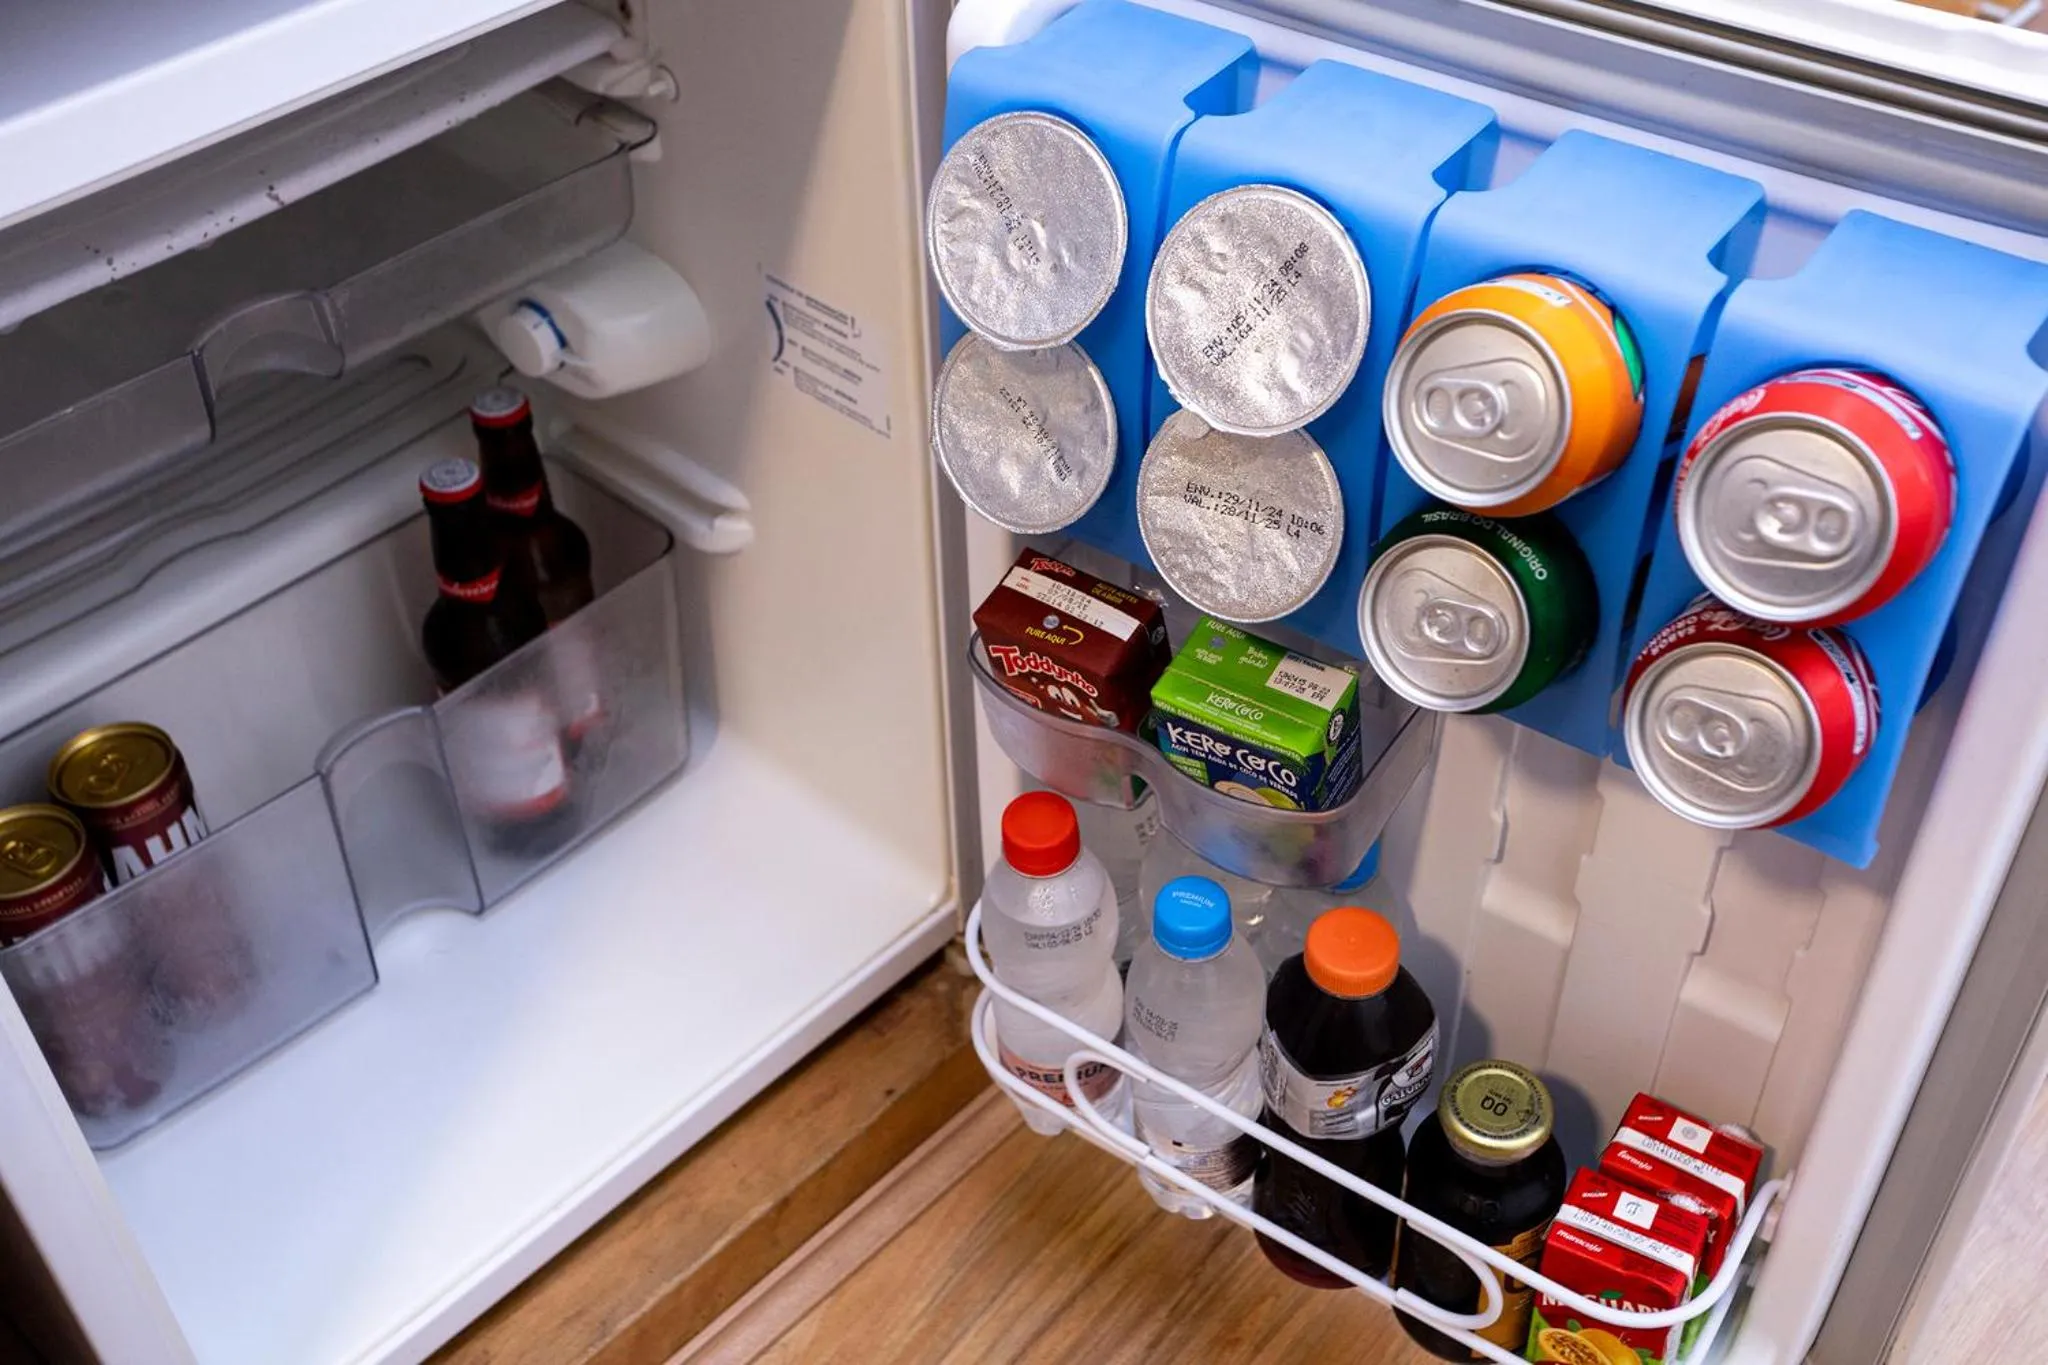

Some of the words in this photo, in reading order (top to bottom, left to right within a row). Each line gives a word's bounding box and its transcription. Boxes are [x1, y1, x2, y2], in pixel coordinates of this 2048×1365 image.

[1290, 514, 1325, 535] 10:06
[1421, 511, 1471, 524] BRASIL
[1471, 516, 1496, 530] DO
[1287, 524, 1301, 539] L4
[1496, 523, 1548, 581] ORIGINAL
[1046, 633, 1067, 646] AQUI
[1650, 626, 1697, 656] SABOR
[989, 646, 1098, 698] Toddynho
[1166, 722, 1232, 758] KERO
[1480, 1096, 1508, 1116] 00
